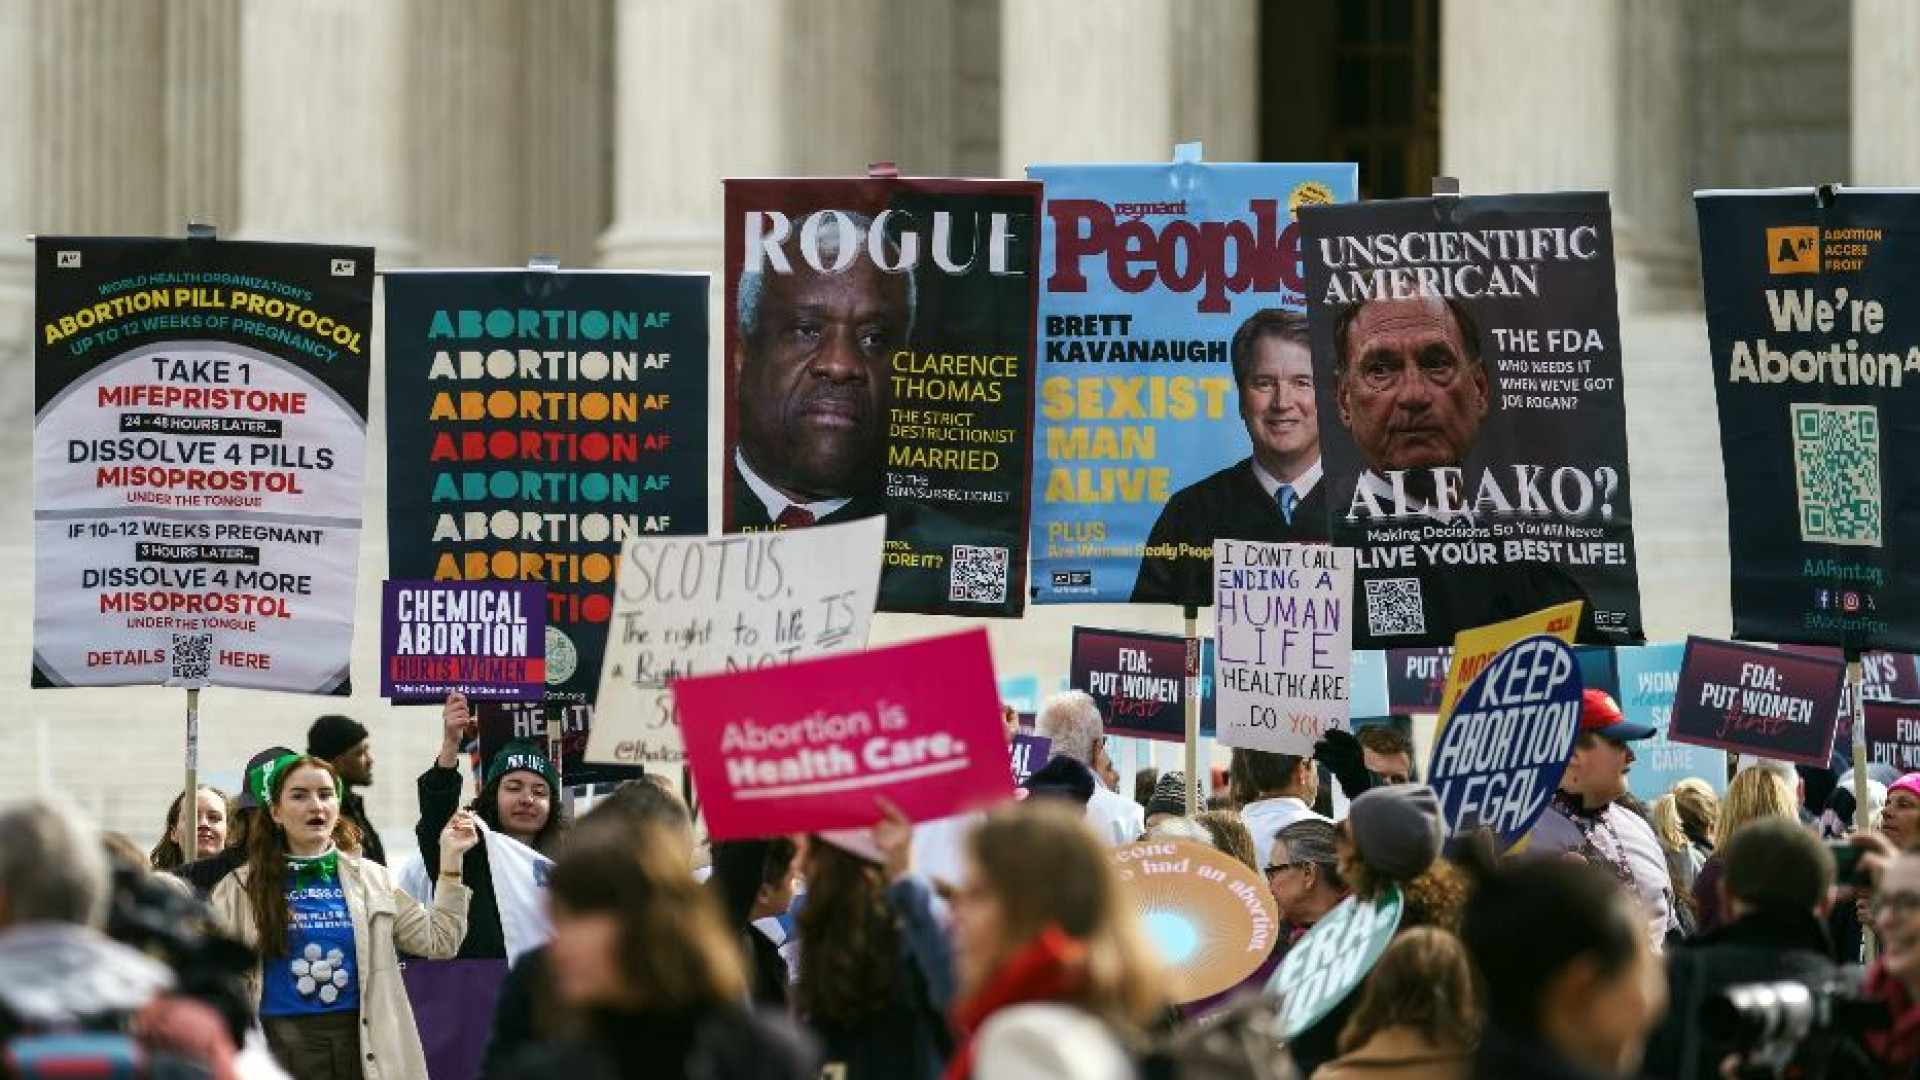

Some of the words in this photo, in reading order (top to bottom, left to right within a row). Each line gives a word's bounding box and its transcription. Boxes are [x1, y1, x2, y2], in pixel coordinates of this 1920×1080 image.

[1115, 200, 1187, 217] regnant
[744, 209, 1026, 276] ROGUE
[1318, 225, 1597, 269] UNSCIENTIFIC
[98, 275, 147, 295] WORLD
[150, 273, 200, 285] HEALTH
[203, 273, 312, 301] ORGANIZATION'S
[1323, 265, 1540, 304] AMERICAN
[45, 288, 170, 345] ABORTION
[175, 288, 225, 308] PILL
[230, 291, 361, 353] PROTOCOL
[427, 309, 638, 340] ABORTION
[644, 312, 671, 328] AF
[1046, 314, 1134, 336] BRETT
[1765, 287, 1885, 335] We're
[70, 336, 94, 356] UP
[94, 327, 119, 345] TO
[121, 321, 140, 336] 12
[144, 315, 202, 331] WEEKS
[206, 315, 229, 328] OF
[232, 318, 339, 363] PREGNANCY
[1046, 341, 1228, 363] KAVANAUGH
[1492, 328, 1540, 352] THE
[1547, 328, 1604, 352] FDA
[152, 357, 230, 384] TAKE
[238, 363, 251, 384] 1
[427, 349, 638, 381] ABORTION
[644, 353, 671, 369] AF
[892, 351, 1018, 378] CLARENCE
[1498, 359, 1528, 373] WHO
[1531, 361, 1575, 373] NEEDS
[1578, 360, 1592, 373] IT
[1729, 338, 1902, 388] Abortion
[890, 376, 1001, 402] THOMAS
[1042, 375, 1231, 420] SEXIST
[1499, 378, 1538, 391] WHEN
[1540, 379, 1581, 392] WE'VE
[1584, 377, 1614, 392] GOT
[98, 385, 307, 415] MIFEPRISTONE
[429, 390, 638, 422] ABORTION
[644, 394, 670, 410] AF
[1501, 394, 1523, 410] JOE
[1526, 396, 1579, 410] ROGAN?
[125, 415, 141, 427] 24
[171, 417, 219, 430] HOURS
[890, 408, 919, 423] THE
[923, 411, 975, 427] STRICT
[430, 430, 638, 462] ABORTION
[644, 434, 671, 450] AF
[890, 425, 1015, 443] DESTRUCTIONIST
[1046, 425, 1156, 460] MAN
[68, 437, 216, 465] DISSOLVE
[224, 441, 242, 465] 4
[250, 444, 335, 470] PILLS
[888, 445, 999, 472] MARRIED
[97, 466, 304, 495] MISOPROSTOL
[431, 470, 638, 503] ABORTION
[644, 474, 671, 491] AF
[886, 472, 904, 484] TO
[905, 475, 929, 486] THE
[1046, 467, 1172, 504] ALIVE
[1346, 463, 1620, 521] ALEAKO?
[127, 492, 172, 505] UNDER
[174, 495, 200, 506] THE
[203, 496, 262, 508] TONGUE
[68, 524, 85, 538] IF
[88, 521, 139, 538] 10-12
[142, 521, 211, 540] WEEKS
[215, 524, 324, 545] PREGNANT
[431, 510, 638, 542] ABORTION
[644, 515, 671, 532] AF
[1050, 521, 1107, 542] PLUS
[1367, 527, 1421, 542] Making
[1423, 526, 1490, 540] Decisions
[1494, 524, 1514, 536] So
[1516, 521, 1540, 536] You
[1565, 527, 1604, 538] Never
[141, 544, 149, 556] 3
[151, 545, 199, 558] HOURS
[1136, 543, 1178, 561] Really
[1222, 542, 1234, 565] I
[1302, 548, 1341, 570] CALL
[1355, 544, 1417, 568] LIVE
[1420, 542, 1499, 565] YOUR
[1504, 539, 1563, 562] BEST
[1567, 542, 1627, 565] LIFE!
[82, 567, 207, 589] DISSOLVE
[212, 568, 229, 588] 4
[235, 571, 312, 595] MORE
[433, 550, 621, 583] ABORTIO
[1219, 569, 1300, 591] ENDING
[1314, 571, 1333, 591] A
[100, 591, 291, 618] MISOPROSTOL
[398, 589, 527, 624] CHEMICAL
[1217, 590, 1341, 632] HUMAN
[127, 617, 173, 629] UNDER
[174, 618, 199, 630] THE
[201, 618, 256, 632] TONGUE
[617, 609, 648, 645] The
[664, 618, 712, 650] right
[734, 611, 758, 646] to
[776, 607, 806, 643] life
[820, 590, 857, 634] IS
[397, 622, 527, 657] ABORTION
[1217, 624, 1335, 669] LIFE
[87, 649, 166, 668] DETAILS
[219, 650, 271, 670] HERE
[396, 657, 451, 682] HURTS
[458, 658, 526, 682] WOMEN
[1119, 647, 1152, 674] FDA:
[1406, 655, 1439, 679] PUT
[1090, 671, 1120, 696] PUT
[1121, 674, 1178, 704] WOMEN
[1478, 641, 1572, 709] KEEP
[1740, 661, 1783, 692] FDA:
[1700, 682, 1740, 711] PUT
[1742, 688, 1814, 725] WOMEN
[721, 709, 872, 754] Abortion
[876, 699, 908, 732] is
[1435, 700, 1580, 779] ABORTION
[725, 745, 857, 789] Health
[862, 731, 968, 771] Care.
[1141, 857, 1191, 875] had
[1197, 865, 1227, 882] an
[1229, 880, 1271, 951] abortion
